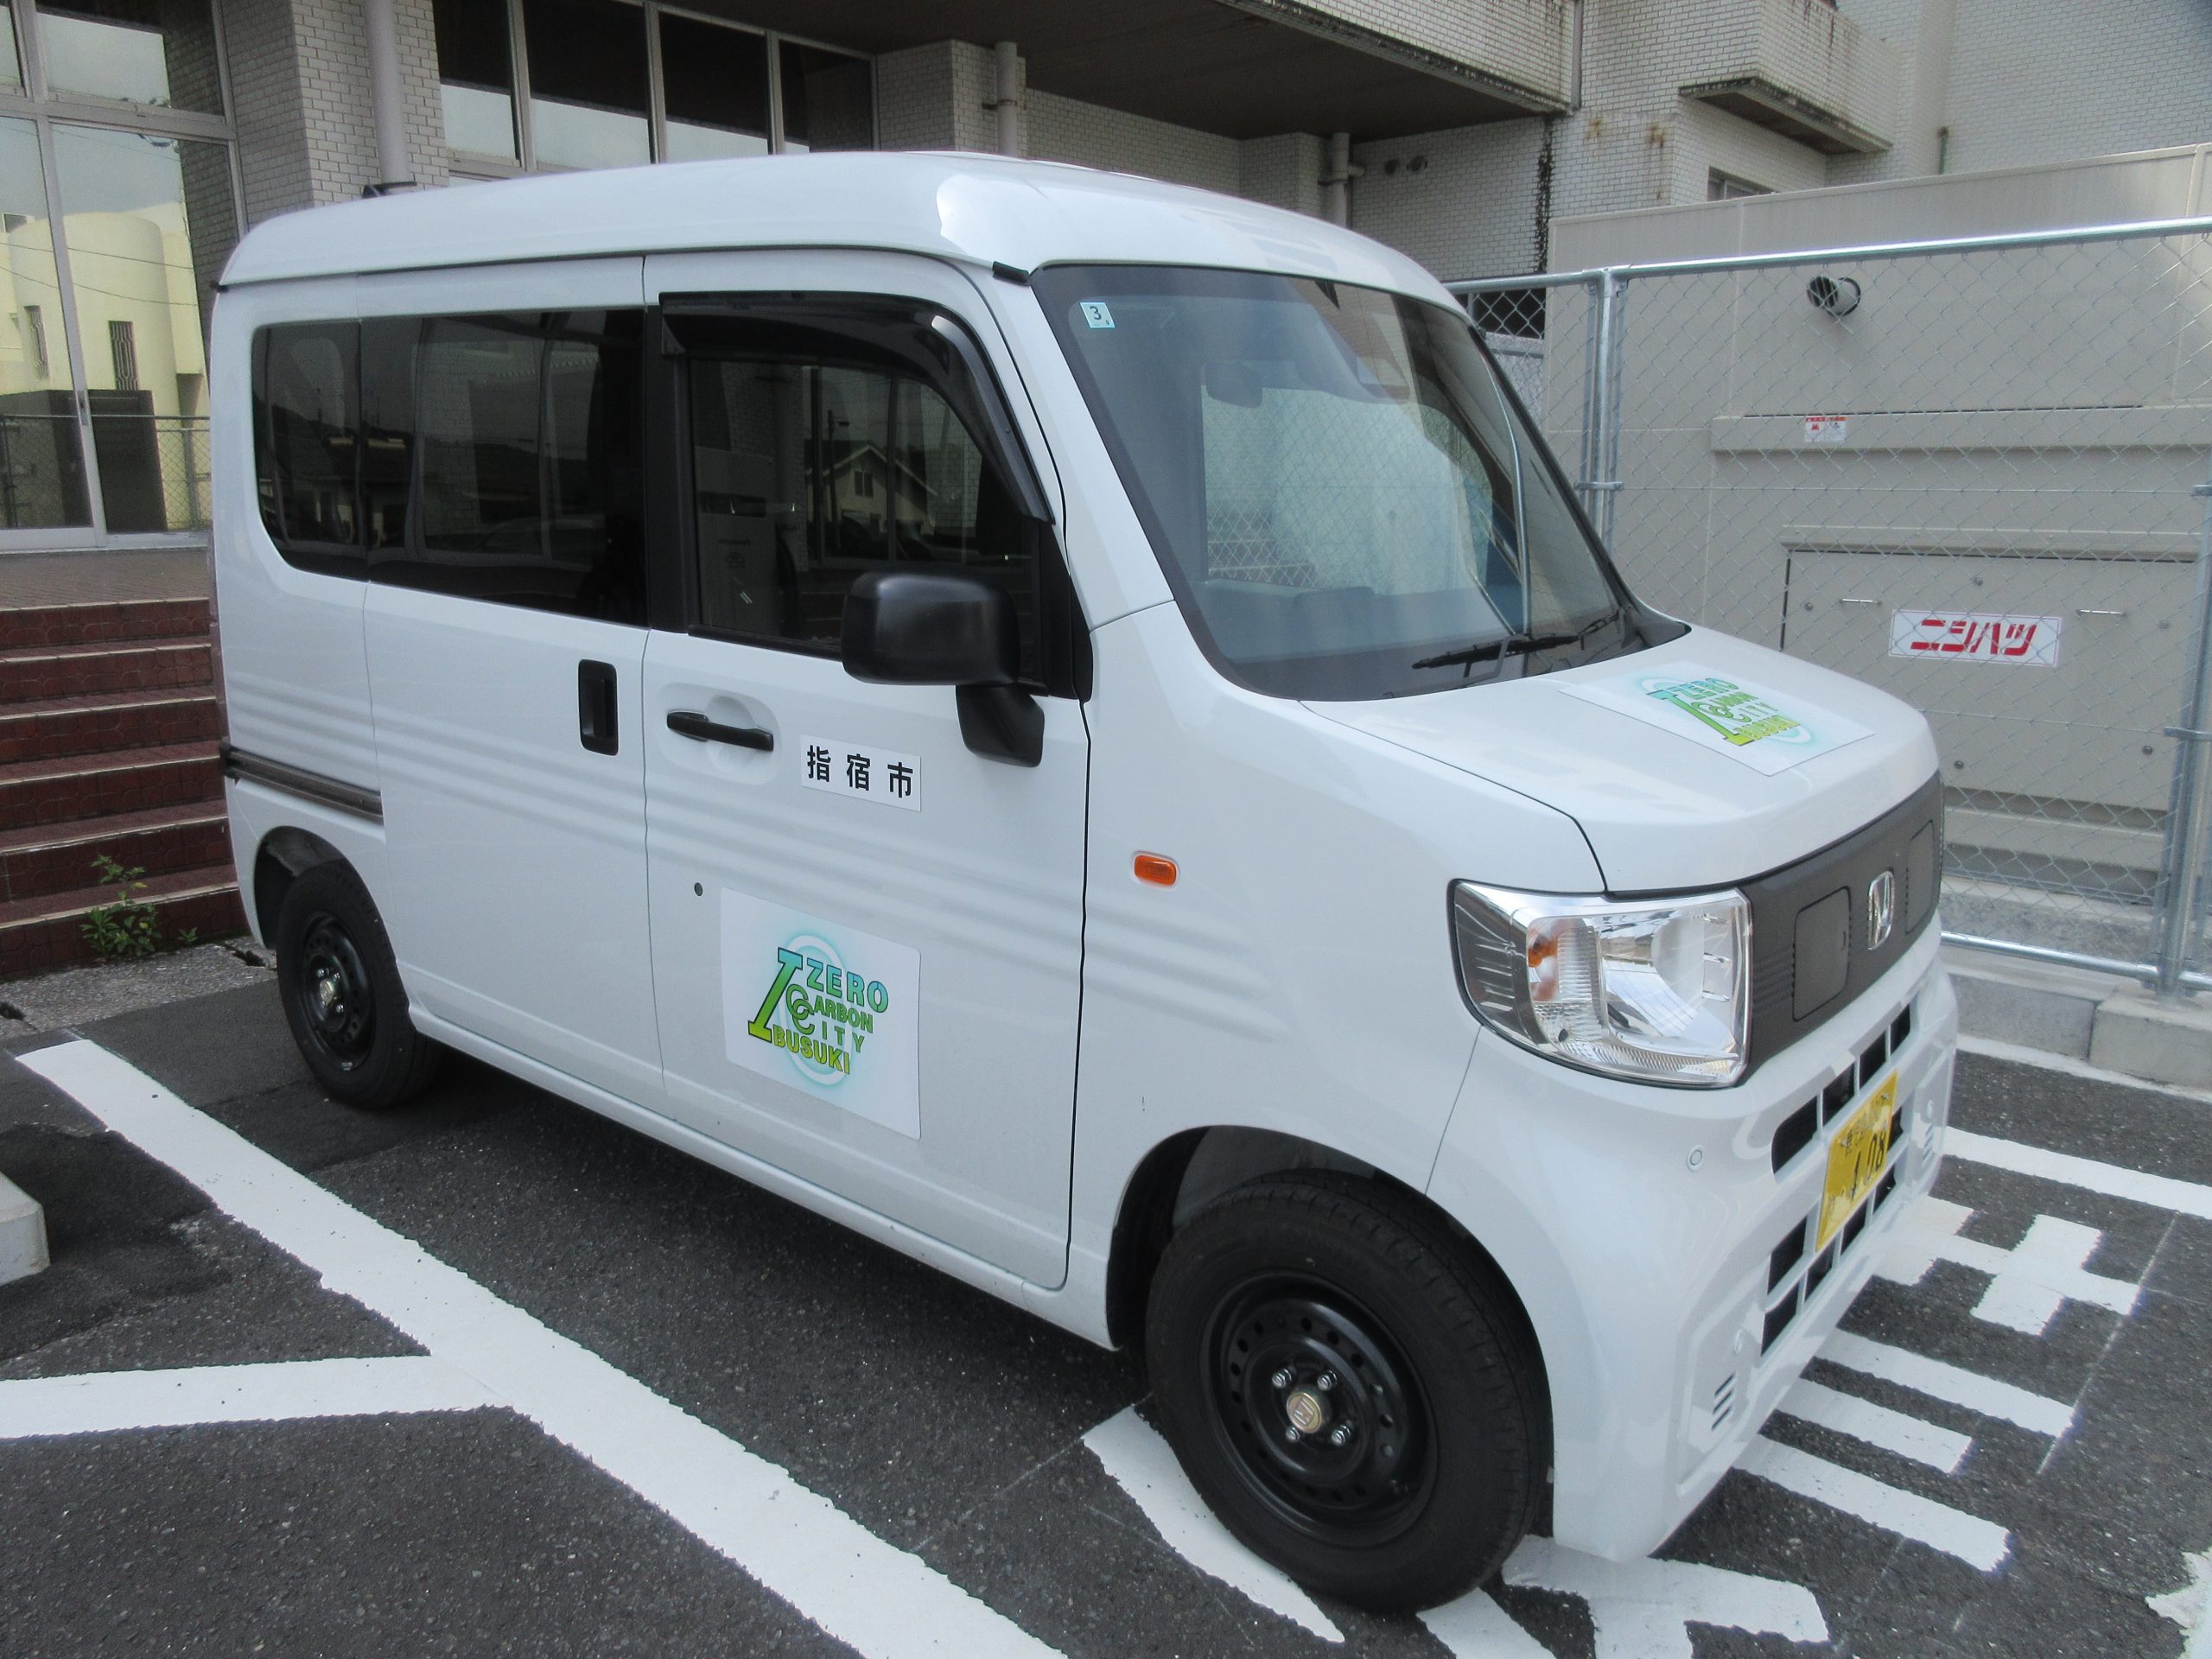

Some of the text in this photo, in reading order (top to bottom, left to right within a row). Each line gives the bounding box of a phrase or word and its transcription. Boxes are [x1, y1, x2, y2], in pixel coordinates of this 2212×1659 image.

[1090, 306, 1102, 321] 3
[1910, 619, 2037, 656] ニシハツ
[807, 745, 913, 798] 指宿市
[785, 984, 874, 1033] CARBON
[806, 958, 889, 1014] ZERO
[792, 1001, 865, 1053] CITY
